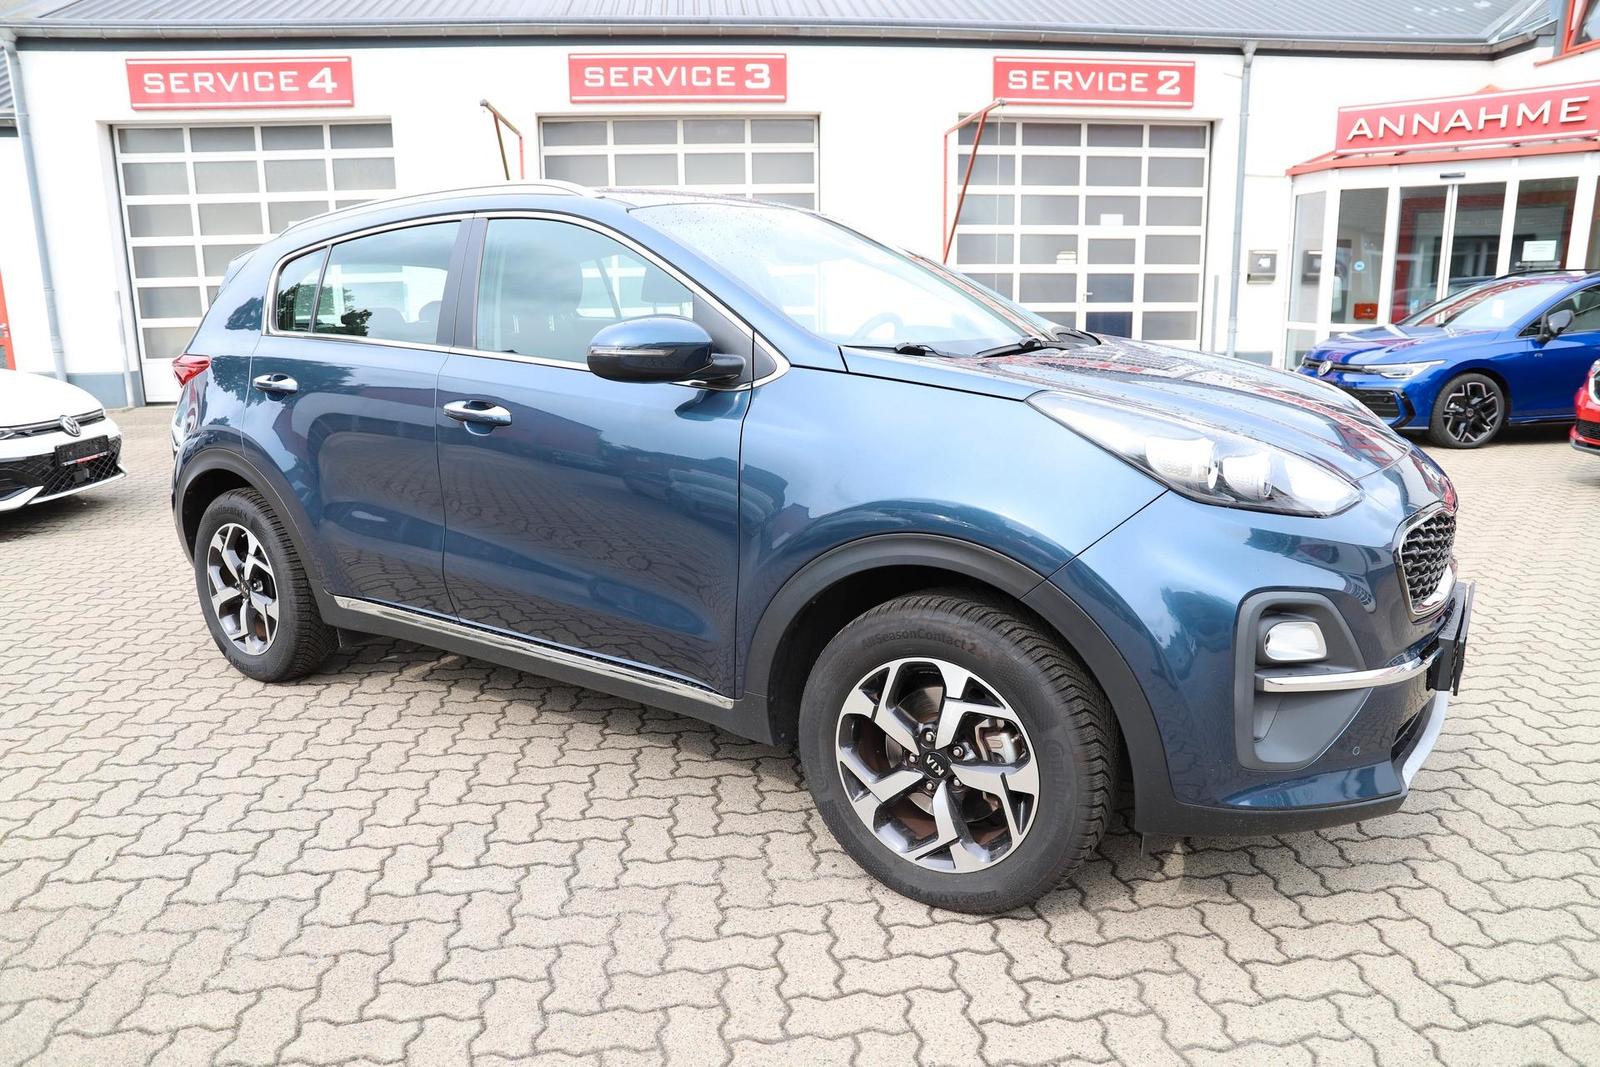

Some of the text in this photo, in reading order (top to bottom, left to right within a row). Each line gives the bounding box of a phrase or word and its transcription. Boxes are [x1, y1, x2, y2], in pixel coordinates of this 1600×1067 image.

[143, 67, 338, 94] SERVICE 4
[584, 63, 771, 89] SERVICE 3
[1007, 70, 1181, 95] SERVICE 2
[1346, 96, 1590, 141] ANNAHME
[926, 754, 945, 776] KIA
